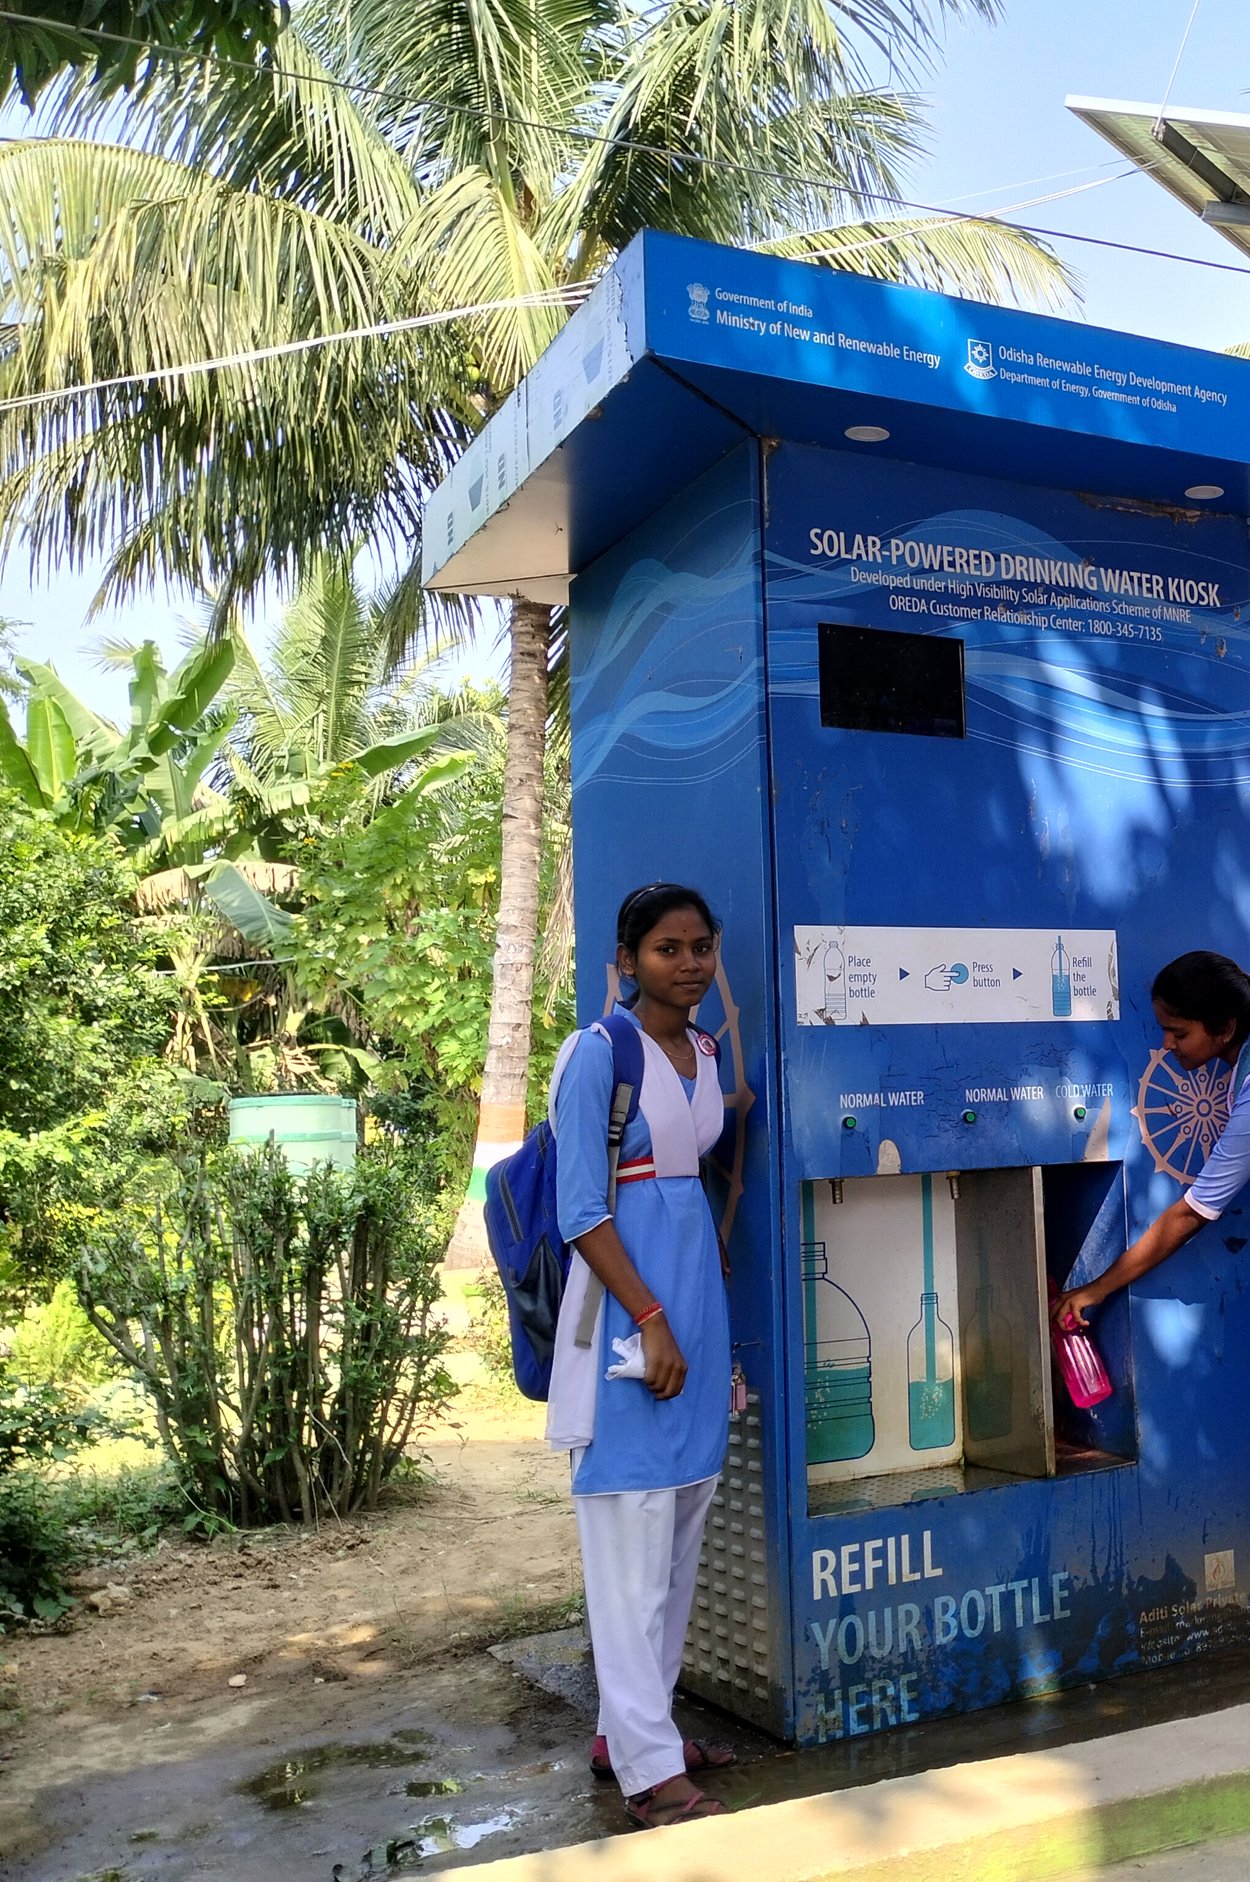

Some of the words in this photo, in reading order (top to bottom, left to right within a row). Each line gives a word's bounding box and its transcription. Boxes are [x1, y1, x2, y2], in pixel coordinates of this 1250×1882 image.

[715, 288, 775, 310] Government
[777, 301, 788, 313] of
[789, 302, 813, 318] India
[716, 309, 766, 336] Ministry
[769, 321, 782, 336] of
[784, 322, 810, 341] New
[813, 331, 835, 346] and
[838, 333, 900, 359] Renewable
[903, 346, 940, 369] Energy
[999, 346, 1034, 365] Odisha
[1036, 353, 1092, 376] Renewable
[1094, 364, 1127, 386] Energy
[1129, 371, 1192, 397] Development
[1194, 385, 1227, 407] Agency
[1000, 368, 1050, 388] Department
[1051, 379, 1060, 389] of
[1061, 380, 1091, 397] Energy,
[1092, 386, 1140, 405] Government
[1142, 396, 1150, 407] of
[1151, 397, 1177, 413] Odisha
[809, 527, 996, 577] SOLAR-POWERED
[1000, 553, 1098, 591] DRINKING
[1099, 567, 1164, 600] WATER
[1168, 576, 1221, 607] KIOSK
[851, 566, 910, 590] Developed
[913, 577, 945, 593] under
[947, 579, 973, 599] High
[975, 581, 1020, 605] Visibility
[1021, 587, 1048, 606] Solar
[1050, 591, 1111, 613] Applications
[1112, 599, 1150, 618] Scheme
[1152, 606, 1162, 619] of
[1163, 607, 1192, 624] MNRE
[889, 594, 928, 614] OREDA
[930, 600, 981, 620] Customer
[984, 605, 1048, 631] Relationship
[1050, 614, 1085, 632] Center:
[1087, 619, 1162, 641] 1800-345-7135
[848, 955, 871, 967] Place
[972, 961, 993, 973] Press
[1072, 956, 1092, 967] Refill
[848, 972, 877, 985] empty
[972, 976, 1001, 988] button
[1072, 971, 1086, 982] the
[849, 986, 876, 998] bottle
[1073, 985, 1097, 996] bottle
[839, 1091, 887, 1109] NORMAL
[888, 1090, 925, 1107] WATER
[965, 1087, 1009, 1103] NORMAL
[1009, 1086, 1044, 1101] WATER
[1055, 1084, 1080, 1098] COLD
[1080, 1083, 1114, 1098] WATER
[812, 1530, 943, 1600] REFILL
[811, 1602, 922, 1671] YOUR
[934, 1571, 1071, 1645] BOTTLE
[1140, 1606, 1168, 1623] Aditi
[1171, 1600, 1202, 1617] Solar
[816, 1671, 920, 1743] HERE
